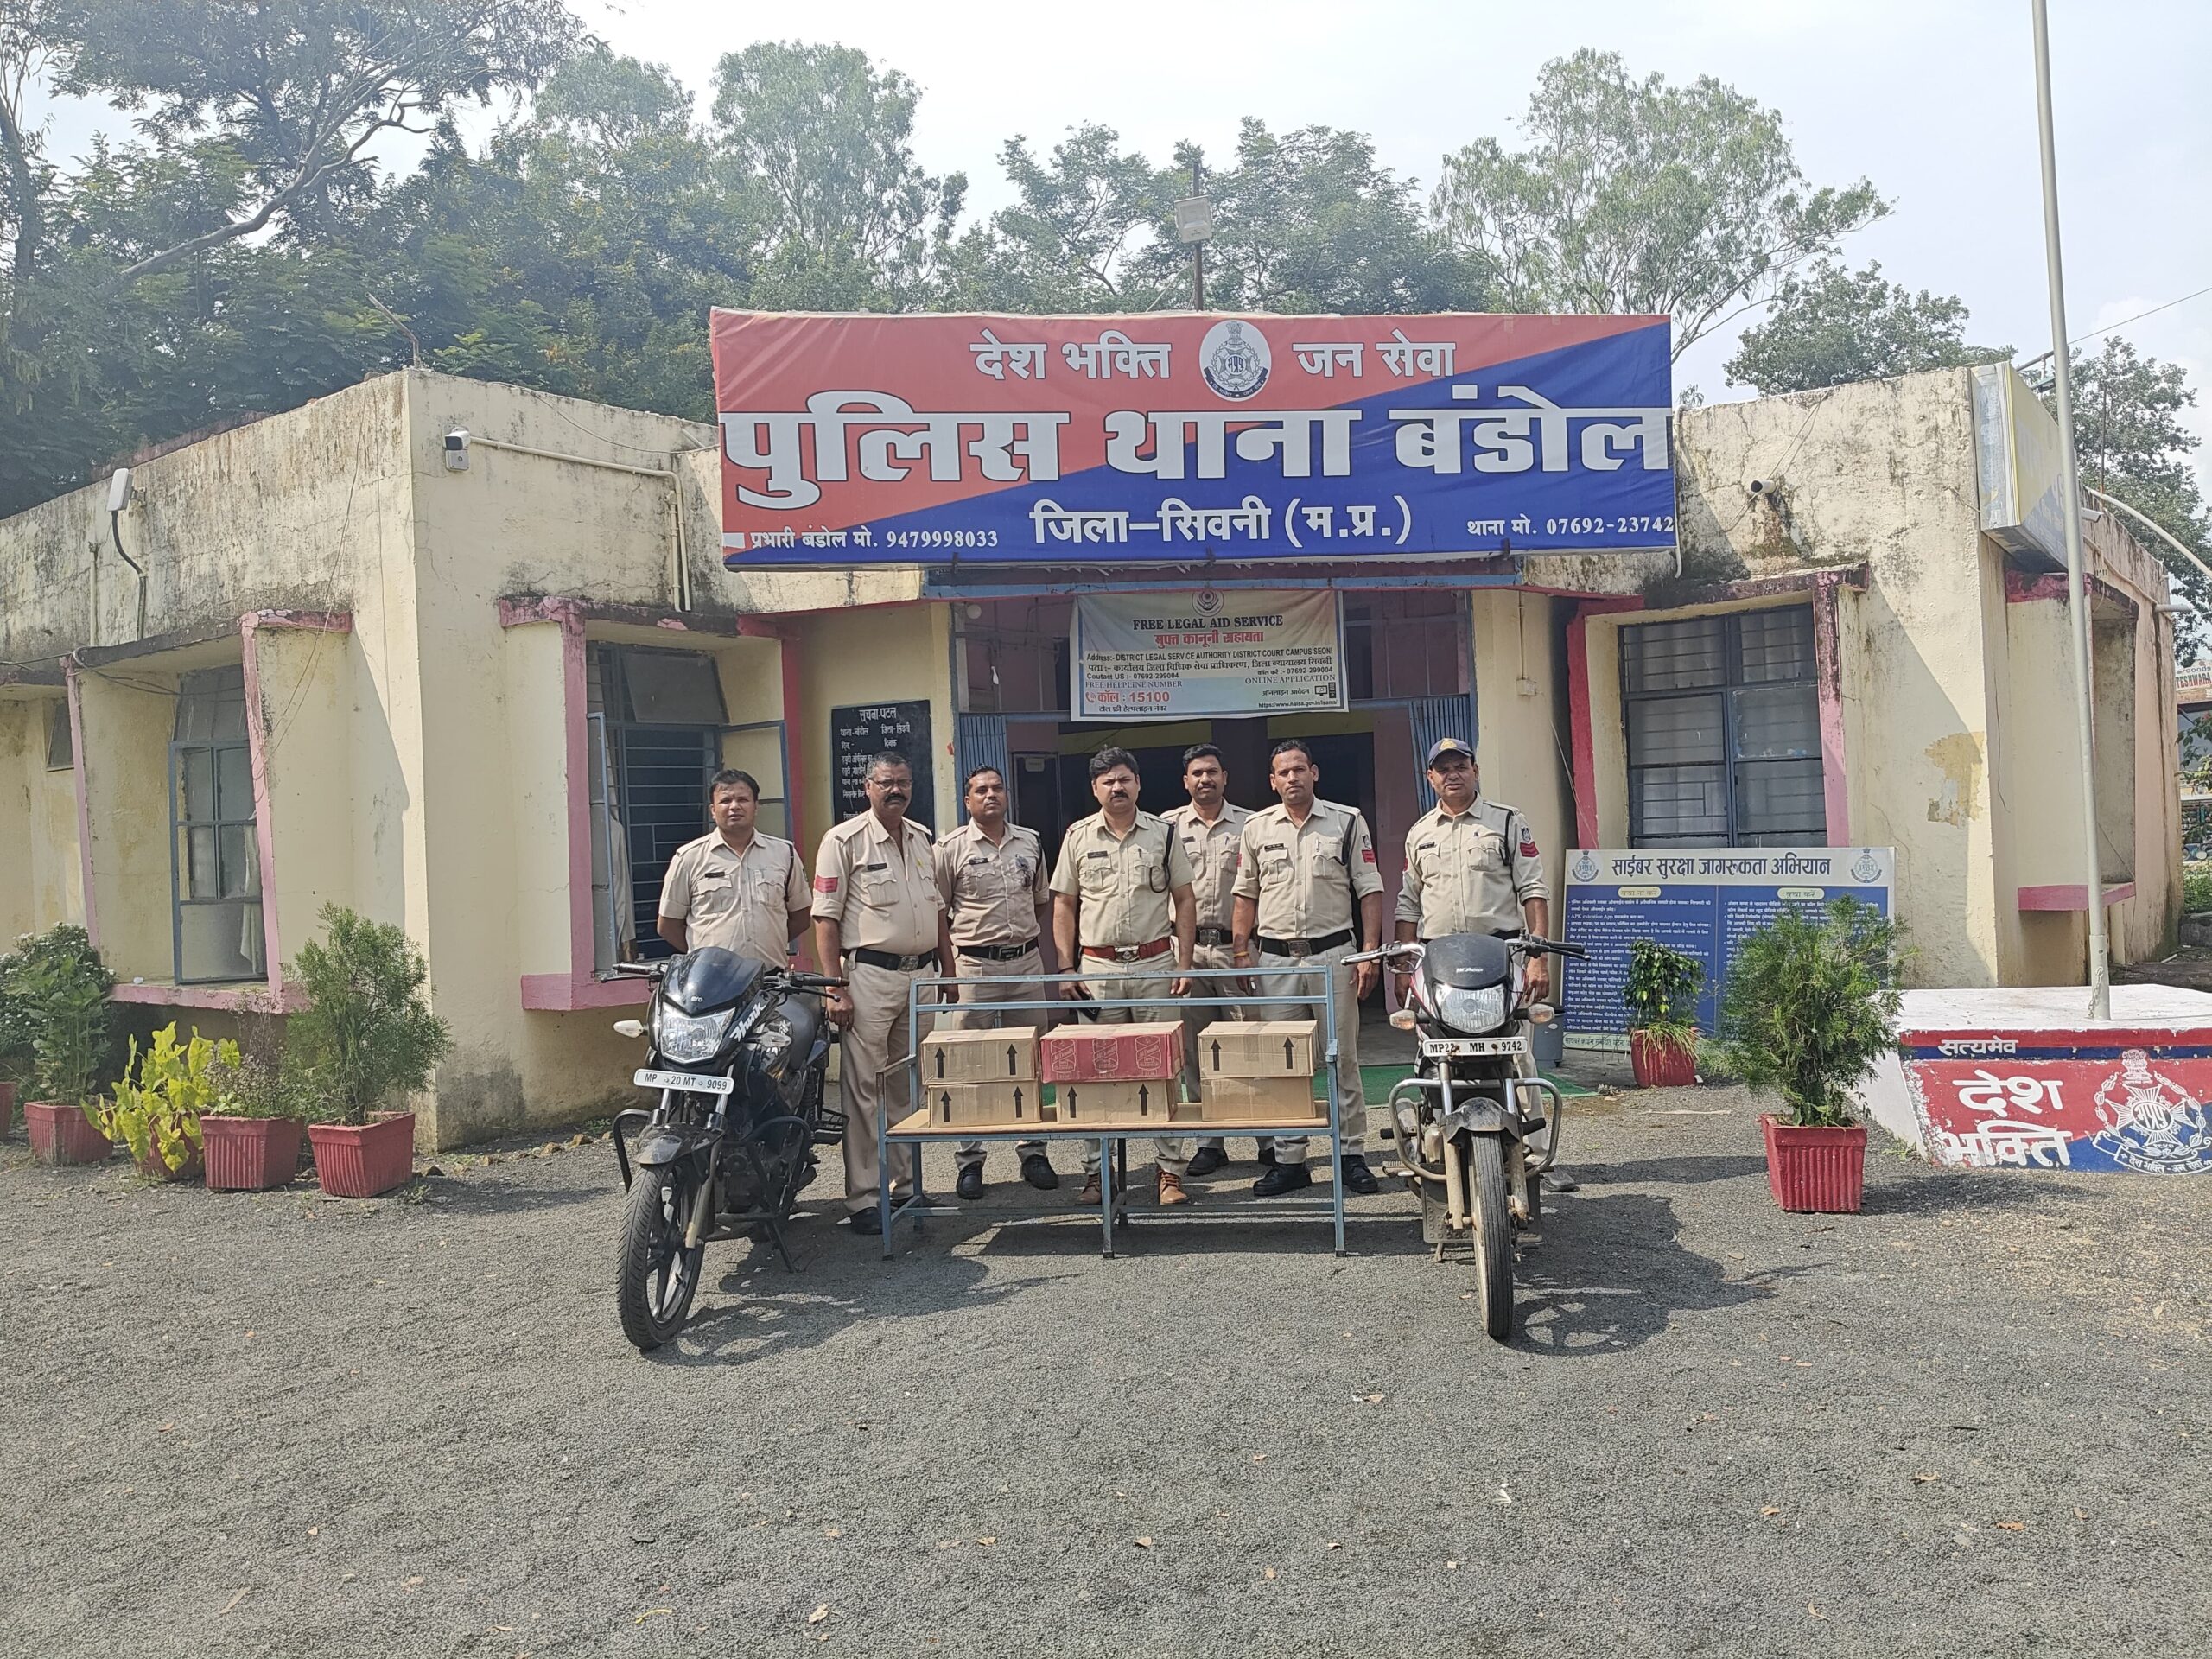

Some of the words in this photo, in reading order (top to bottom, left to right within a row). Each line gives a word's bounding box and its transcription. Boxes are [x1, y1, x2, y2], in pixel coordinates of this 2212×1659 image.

[970, 329, 1046, 380] देश
[1062, 329, 1171, 379] भक्ति
[1293, 342, 1364, 378] जन
[1376, 328, 1456, 377] सेवा
[720, 390, 1070, 509] पुलिस
[1105, 410, 1363, 481] थाना
[1389, 385, 1673, 474] बंडोल
[1467, 519, 1505, 536] थाना
[1546, 516, 1674, 534] 07692-23742
[751, 526, 795, 549] प्रभारी
[802, 524, 847, 549] बंडोल
[887, 530, 999, 548] 9479998033
[1133, 619, 1164, 630] FREE
[1167, 618, 1206, 630] LEGAL
[1210, 617, 1230, 628] AID
[1234, 615, 1283, 626] SERVICE
[1183, 629, 1219, 646] कानूनी
[1223, 632, 1264, 644] सहायता
[1146, 652, 1166, 661] LEGAL
[1196, 650, 1231, 659] AUTHORITY
[1233, 650, 1261, 658] DISTRICT
[1147, 662, 1165, 671] जिला
[1193, 661, 1208, 670] सेवा
[1252, 659, 1270, 668] जिला
[1280, 674, 1336, 683] APPLICATION
[1097, 690, 1119, 702] कॉल
[1129, 691, 1170, 702] 15100
[1611, 855, 1653, 877] साईबर
[1656, 857, 1694, 879] सुरक्षा
[1698, 857, 1768, 877] जागरूकता
[1770, 851, 1831, 877] अभियान
[1470, 1042, 1484, 1052] MH
[1502, 1041, 1522, 1051] 9742
[1938, 1035, 2019, 1055] सत्यमेव
[645, 1073, 657, 1083] MP
[671, 1076, 681, 1085] 20
[683, 1077, 696, 1086] MT
[707, 1079, 728, 1090] 9099
[1952, 1069, 2063, 1117] देश
[1938, 1120, 2073, 1166] भक्ति
